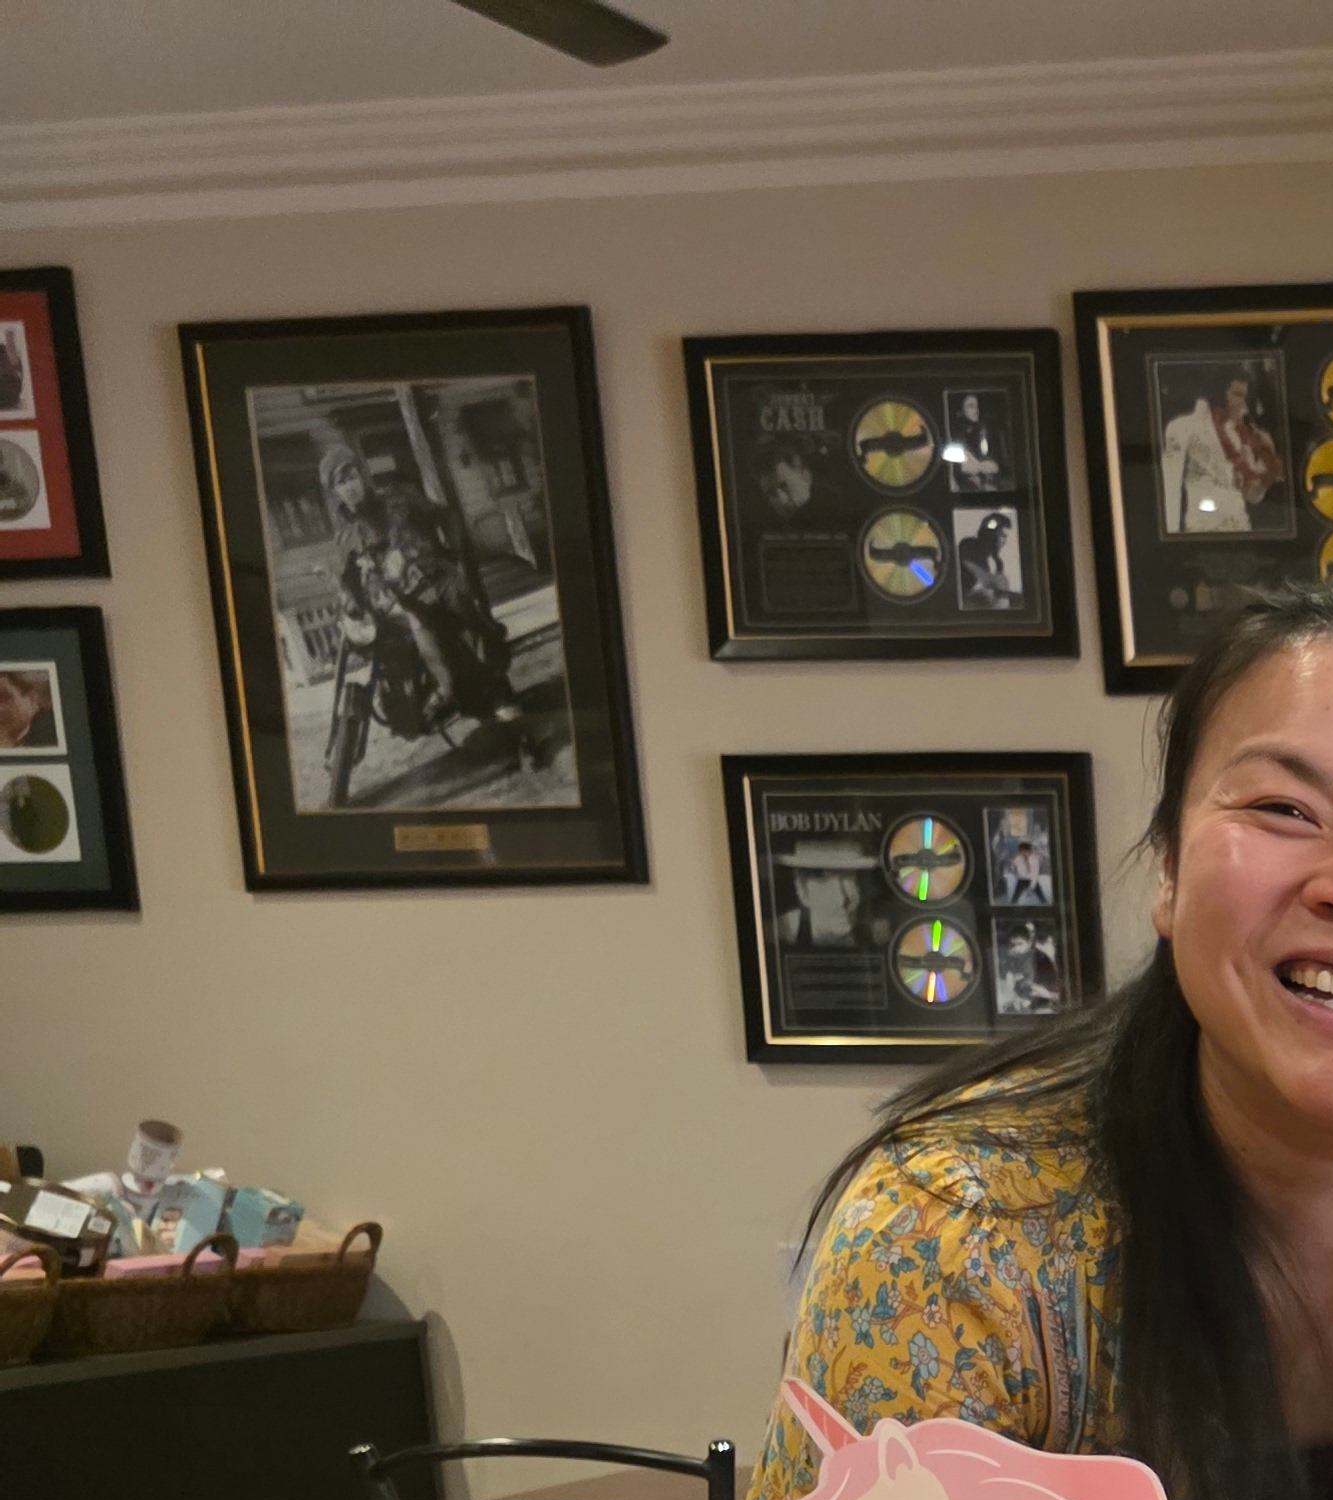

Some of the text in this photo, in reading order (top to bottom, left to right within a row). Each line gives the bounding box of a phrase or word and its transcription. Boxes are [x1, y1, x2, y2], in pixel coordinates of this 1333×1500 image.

[760, 406, 825, 432] CASH
[770, 809, 883, 833] BOB DYLAN
